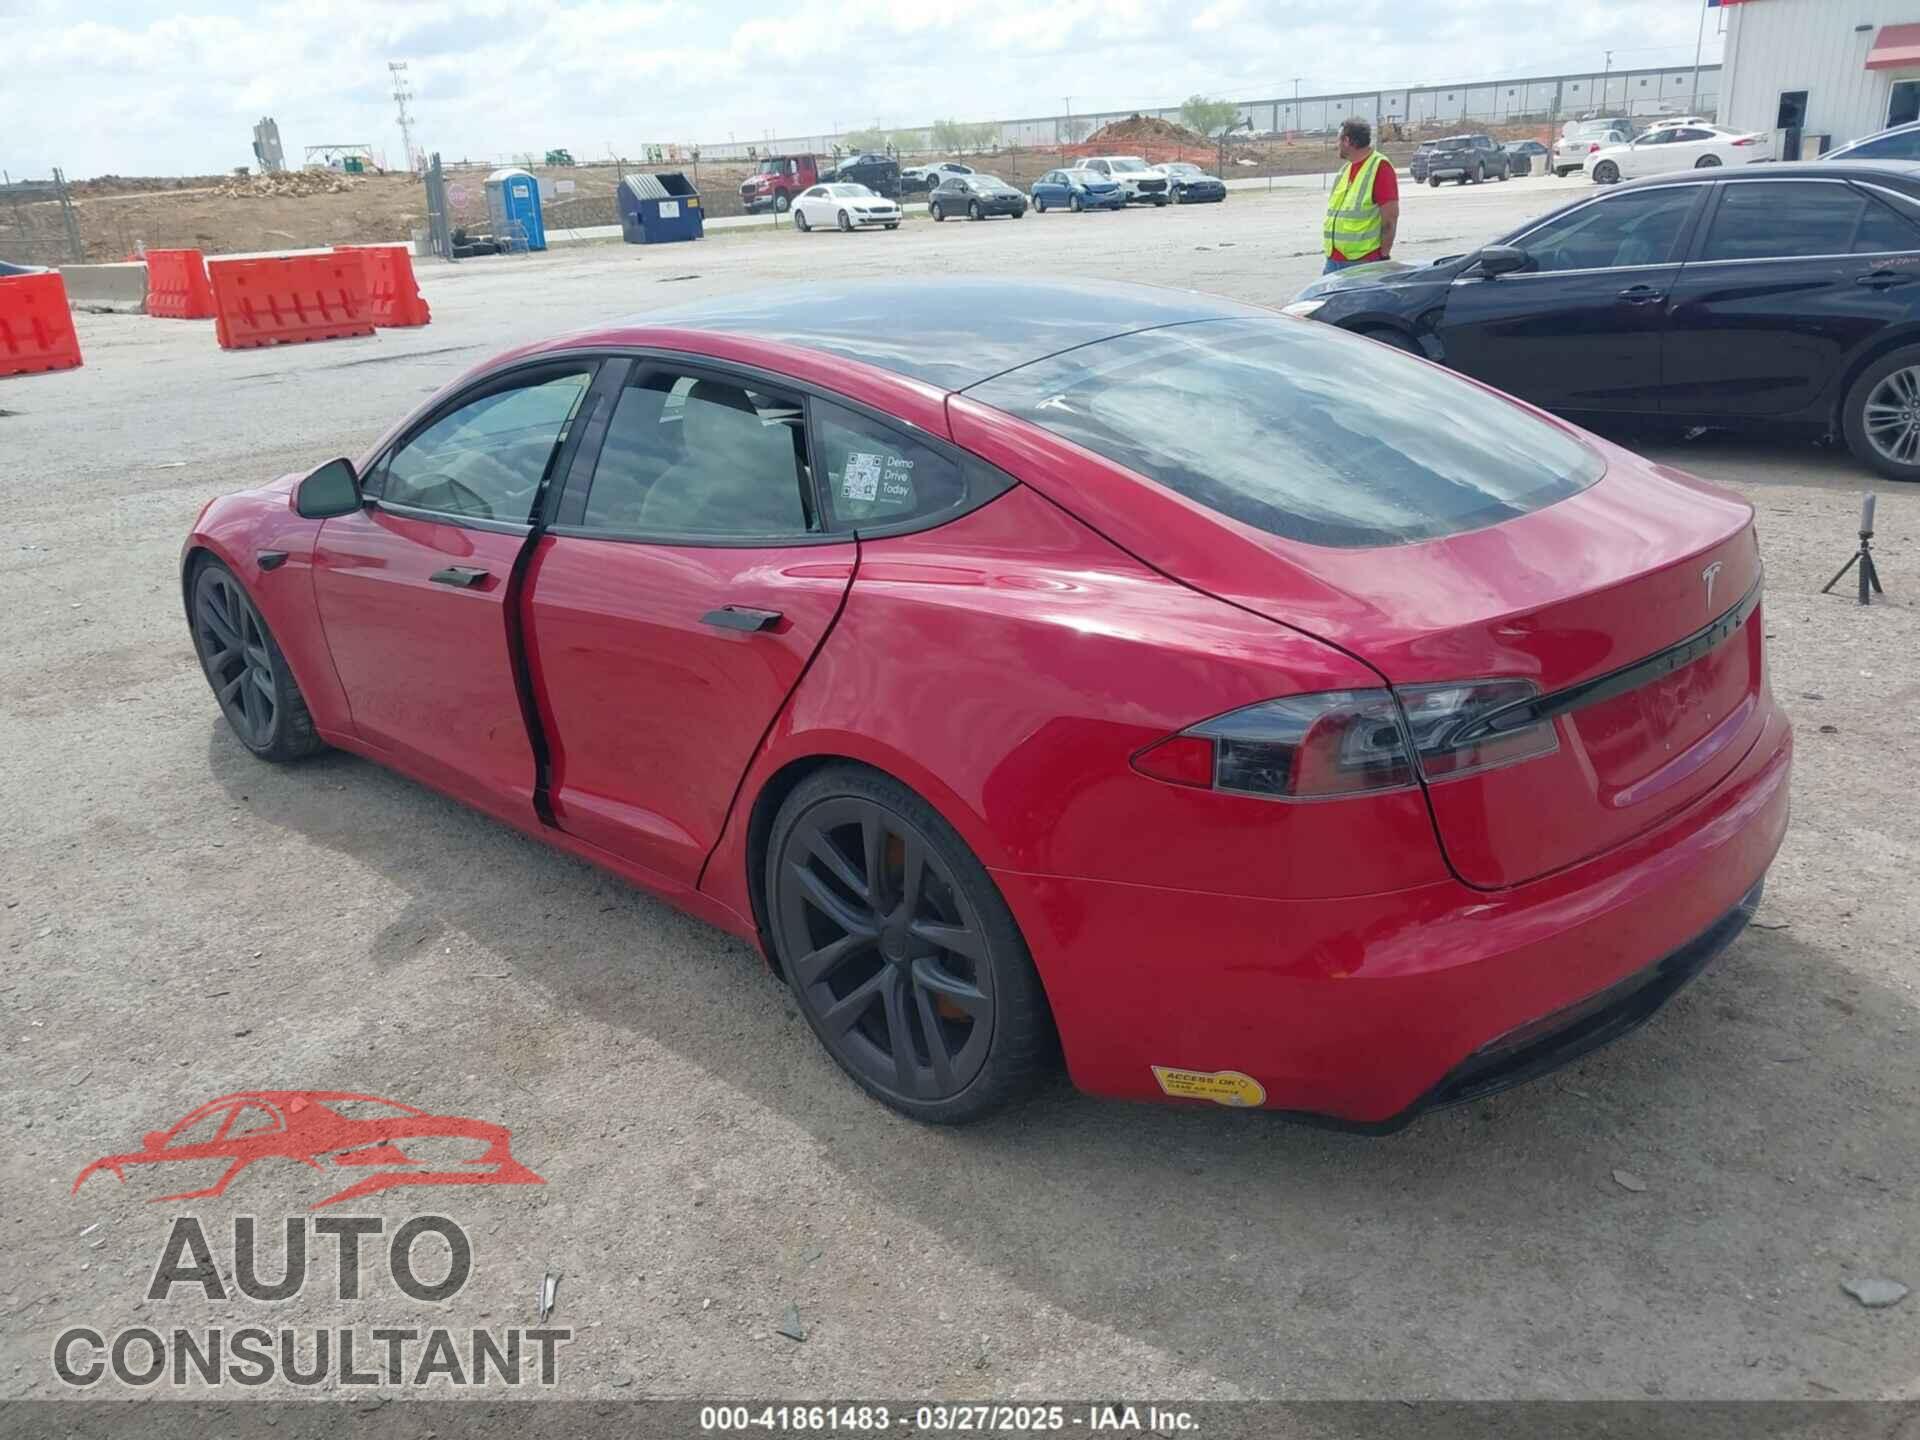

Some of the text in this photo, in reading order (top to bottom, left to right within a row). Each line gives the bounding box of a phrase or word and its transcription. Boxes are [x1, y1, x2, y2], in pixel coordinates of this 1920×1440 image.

[887, 456, 914, 469] Demo
[884, 470, 908, 482] Drive
[883, 482, 910, 497] Today
[1167, 1072, 1214, 1084] ACCESS
